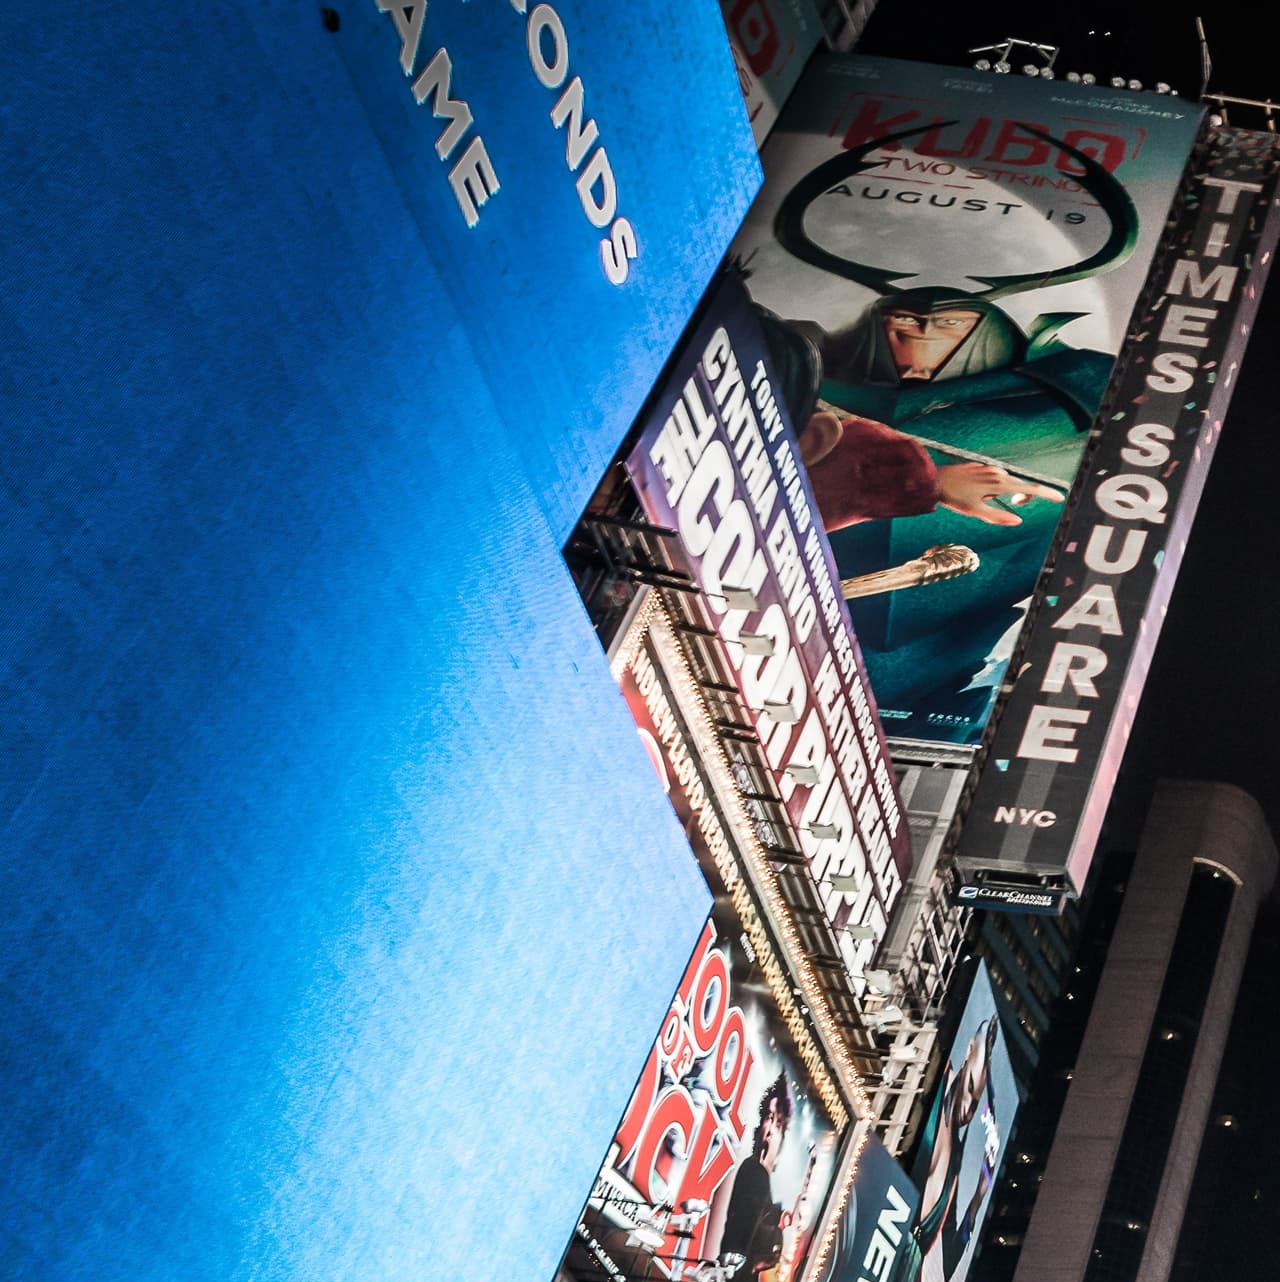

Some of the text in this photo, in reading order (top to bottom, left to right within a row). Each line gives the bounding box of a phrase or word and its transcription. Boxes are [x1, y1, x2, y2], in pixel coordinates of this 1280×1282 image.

[509, 0, 637, 286] ONDS
[826, 184, 1088, 225] AUGUST 19
[842, 98, 1130, 176] KUBO
[880, 155, 957, 177] TWO
[750, 359, 902, 840] TONY AWARD WINNER! BEST MUSICAL REVIVAL
[1016, 176, 1263, 765] TIMES SQUARE
[648, 377, 890, 999] THE COLOR PURPLE
[702, 326, 902, 914] CYNTHIA ERIVO HEATHER HEADLEY
[994, 806, 1057, 828] NYC
